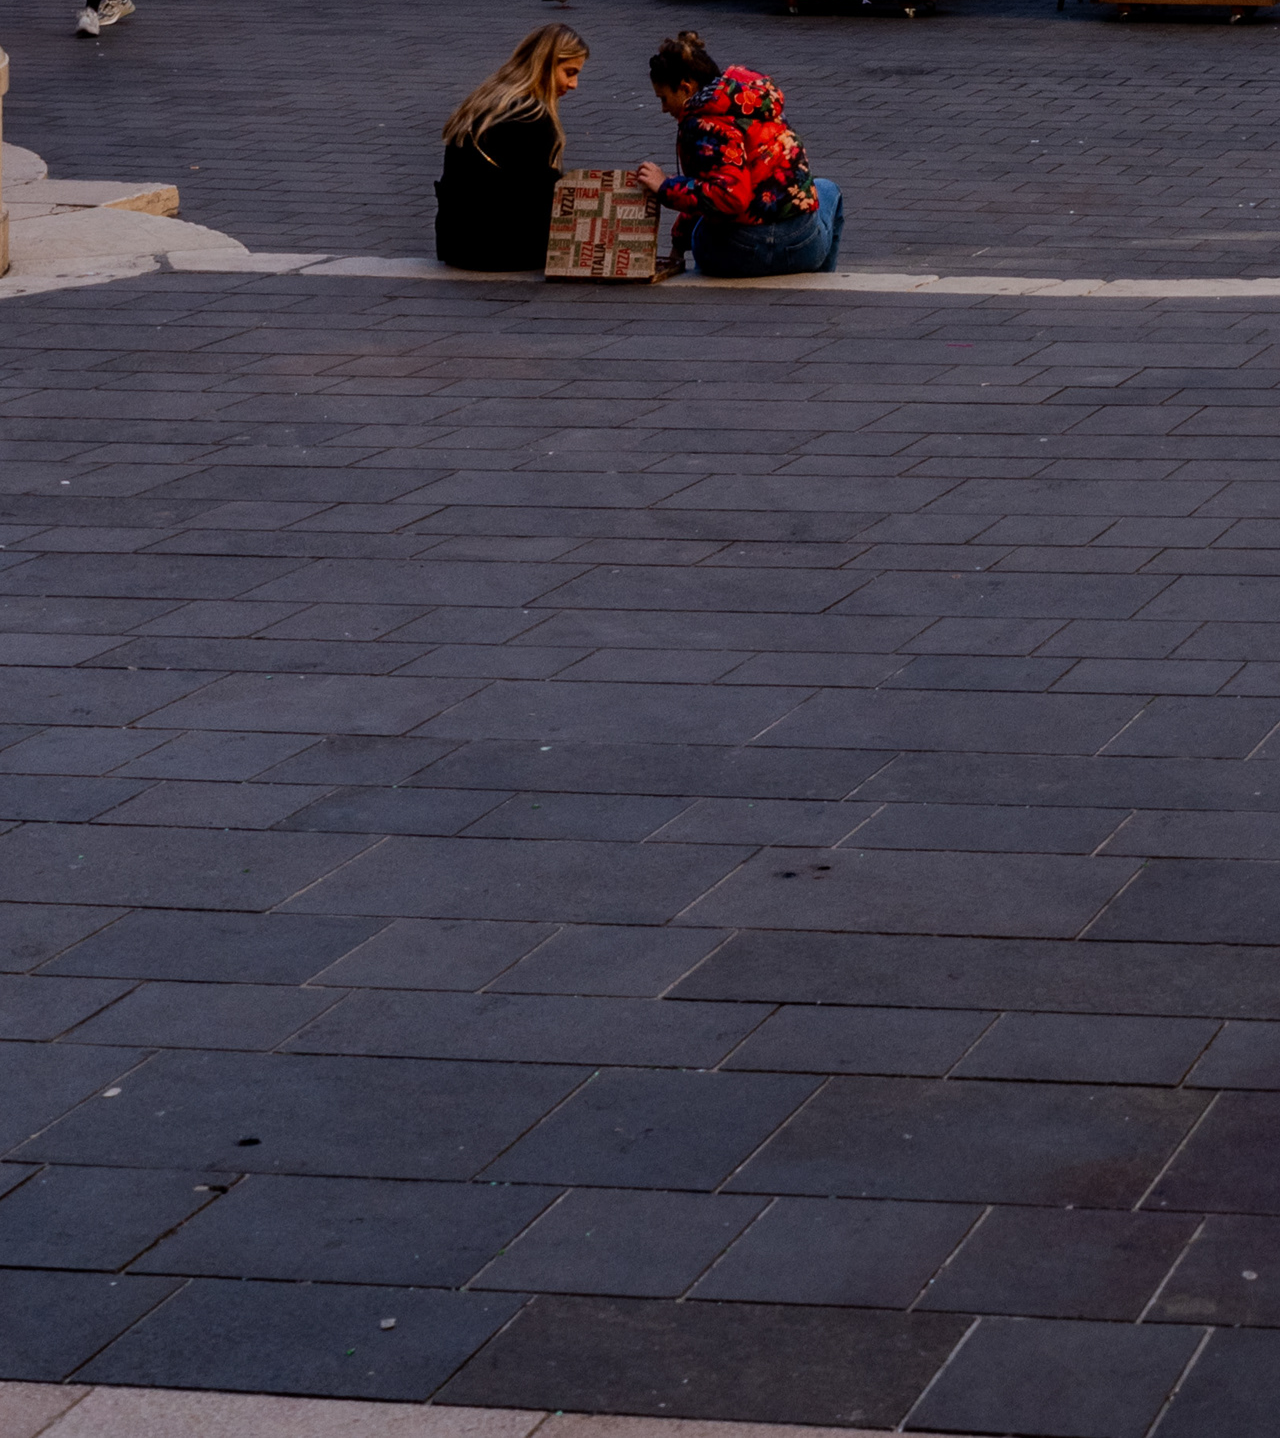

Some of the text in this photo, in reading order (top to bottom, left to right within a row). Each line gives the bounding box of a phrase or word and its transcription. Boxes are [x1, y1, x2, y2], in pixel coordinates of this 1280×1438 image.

[560, 187, 575, 217] PIZZA
[575, 187, 600, 199] ITALIA
[616, 205, 646, 220] PIZZA
[580, 240, 594, 268] PIZZA
[591, 243, 606, 276] ITALIA
[616, 247, 630, 276] PIZZA
